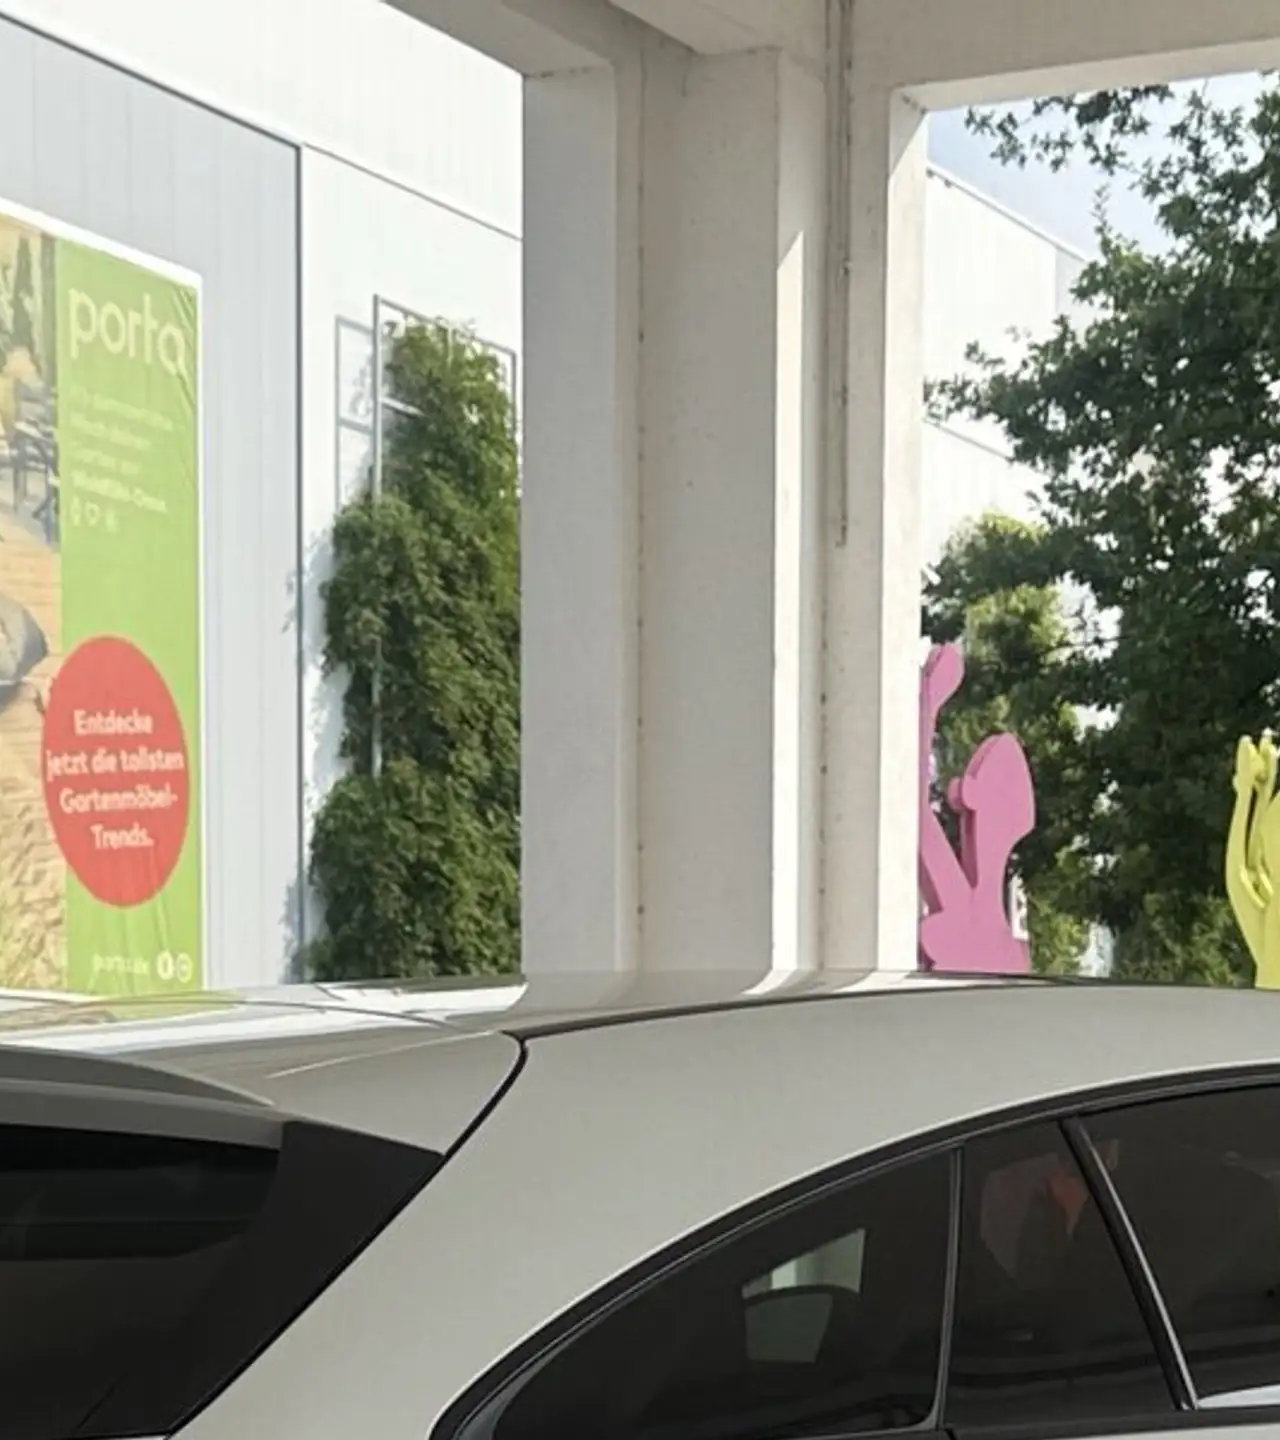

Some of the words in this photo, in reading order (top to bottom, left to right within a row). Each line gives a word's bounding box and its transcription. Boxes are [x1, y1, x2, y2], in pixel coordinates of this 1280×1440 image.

[68, 287, 188, 376] porta
[73, 707, 153, 736] Entdecke
[45, 749, 90, 782] jetzt
[91, 746, 118, 774] die
[119, 743, 185, 773] tollsten
[58, 782, 179, 814] Gartenmöbel-
[90, 820, 155, 850] Trends.
